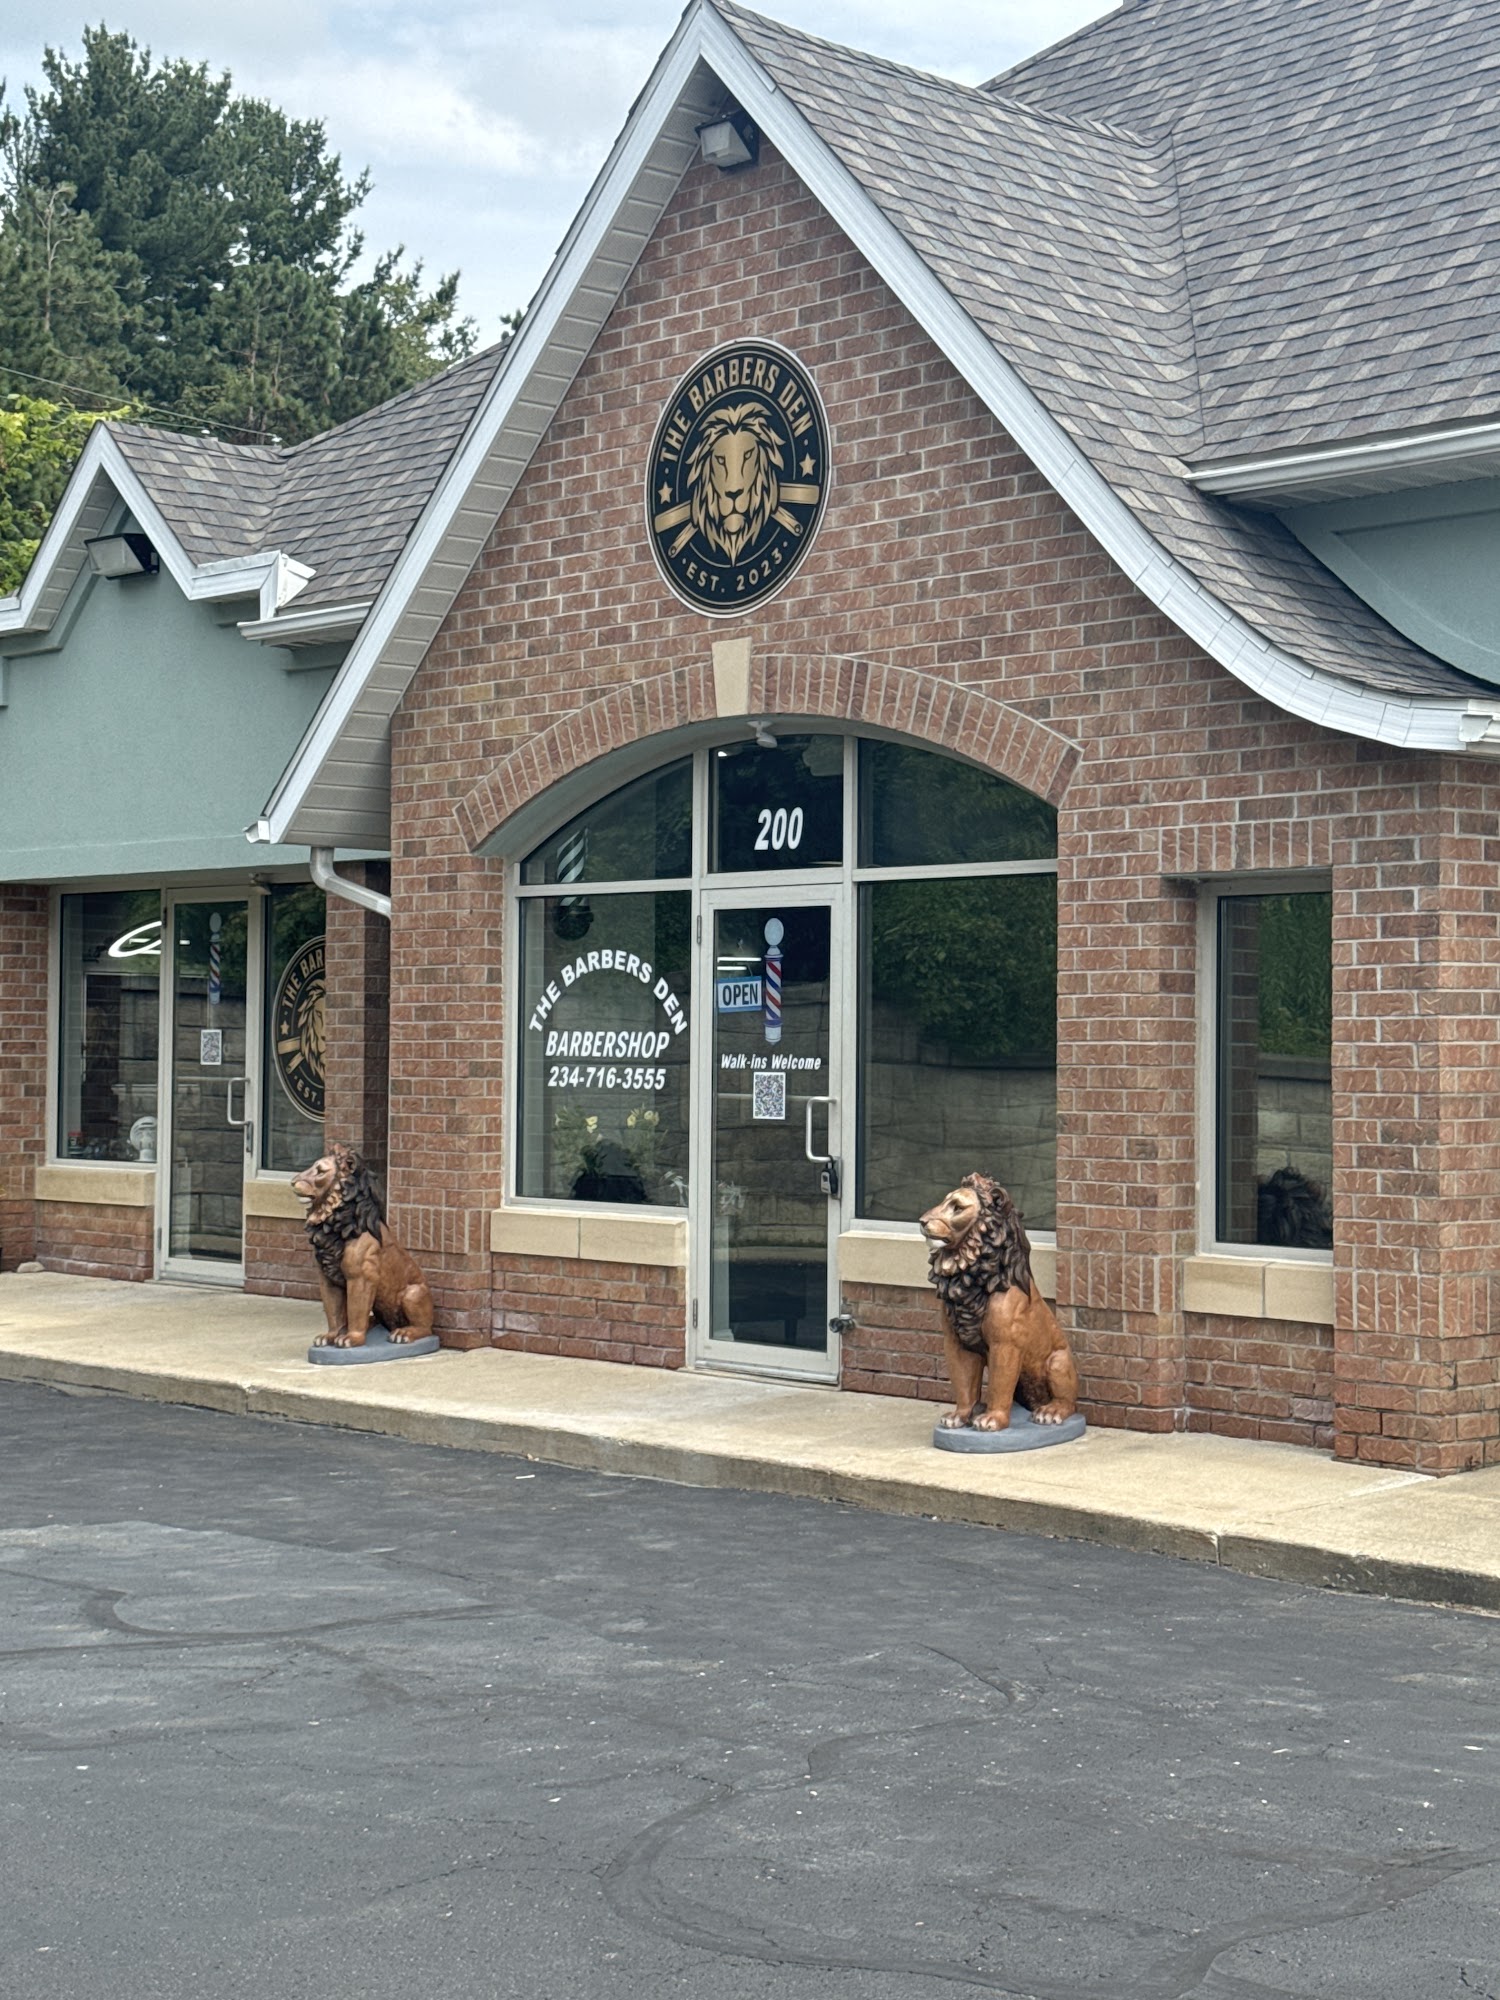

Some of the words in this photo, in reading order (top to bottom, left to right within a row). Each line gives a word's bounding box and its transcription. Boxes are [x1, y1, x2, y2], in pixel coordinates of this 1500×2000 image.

[660, 408, 692, 463] THE
[688, 356, 780, 414] BARBERS
[778, 377, 814, 438] DEN
[685, 560, 726, 594] EST.
[736, 550, 783, 592] 2023
[754, 806, 804, 851] 200
[282, 971, 302, 1008] THE
[529, 980, 561, 1032] THE
[560, 949, 653, 987] BARBERS
[653, 977, 688, 1035] DEN
[722, 982, 759, 1007] OPEN
[545, 1030, 670, 1059] BARBERSHOP
[721, 1053, 768, 1070] Walk-ins
[771, 1053, 822, 1070] Welcome
[547, 1065, 667, 1090] 234-716-3555
